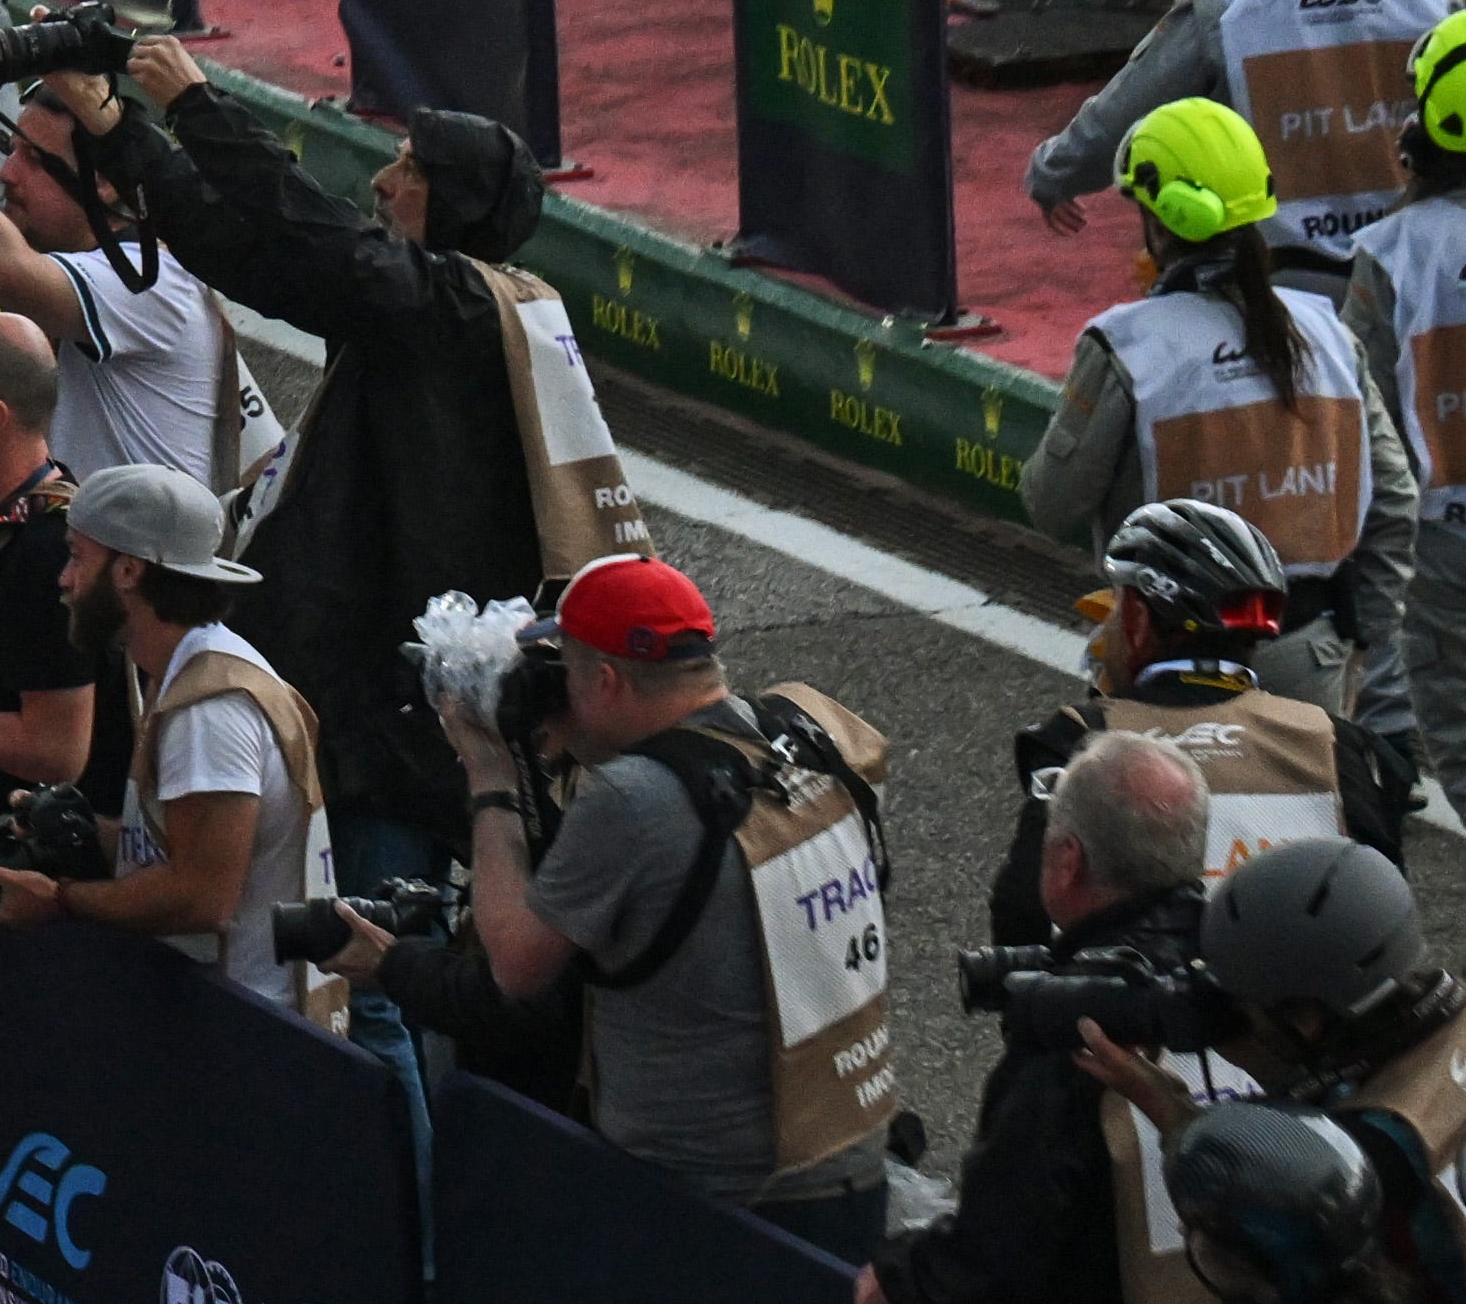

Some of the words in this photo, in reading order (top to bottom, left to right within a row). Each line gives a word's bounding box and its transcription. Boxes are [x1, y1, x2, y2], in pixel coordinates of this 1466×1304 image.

[776, 23, 897, 127] ROLEX
[1279, 107, 1334, 141] PIT
[1302, 208, 1386, 240] ROUN
[592, 294, 662, 351] ROLEX
[708, 340, 780, 398] ROLEX
[829, 389, 903, 447] ROLEX
[796, 858, 880, 932] TRAC
[843, 922, 882, 972] 46
[832, 1027, 890, 1079] ROUN
[856, 1064, 896, 1109] IMO
